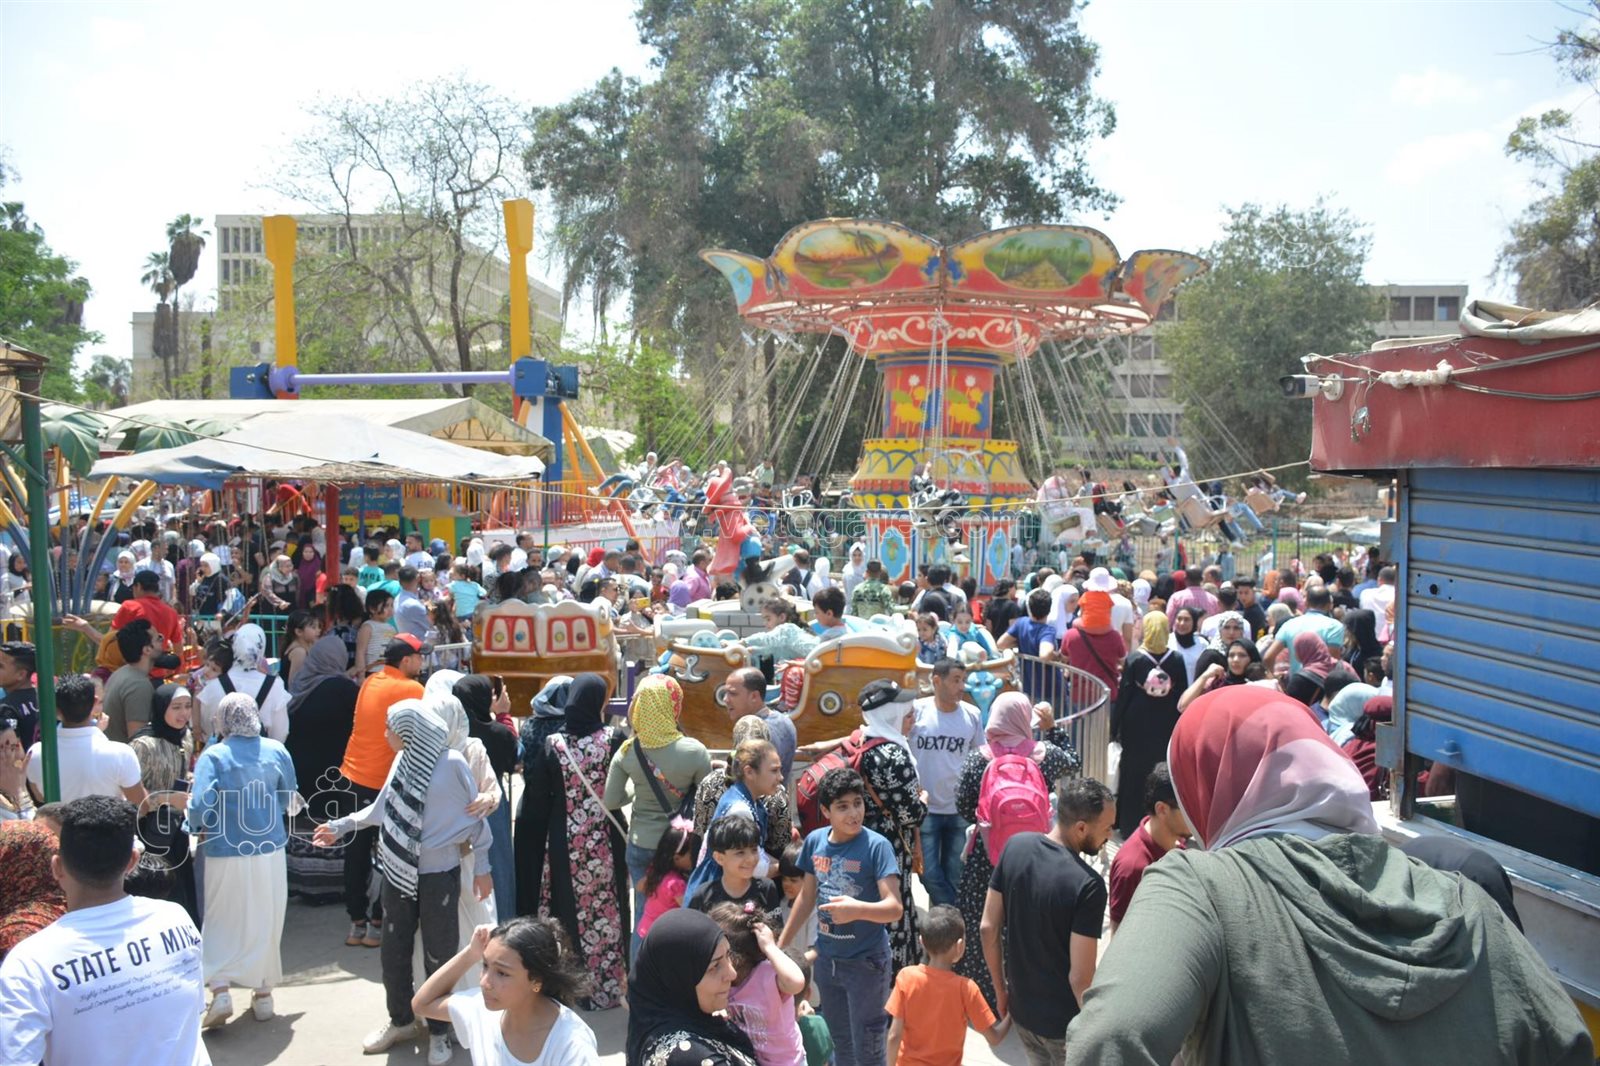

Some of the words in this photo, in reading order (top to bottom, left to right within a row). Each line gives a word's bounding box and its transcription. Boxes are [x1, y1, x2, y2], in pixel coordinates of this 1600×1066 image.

[917, 734, 965, 753] DEXTER
[52, 947, 121, 991] STATE
[126, 937, 151, 966] OF
